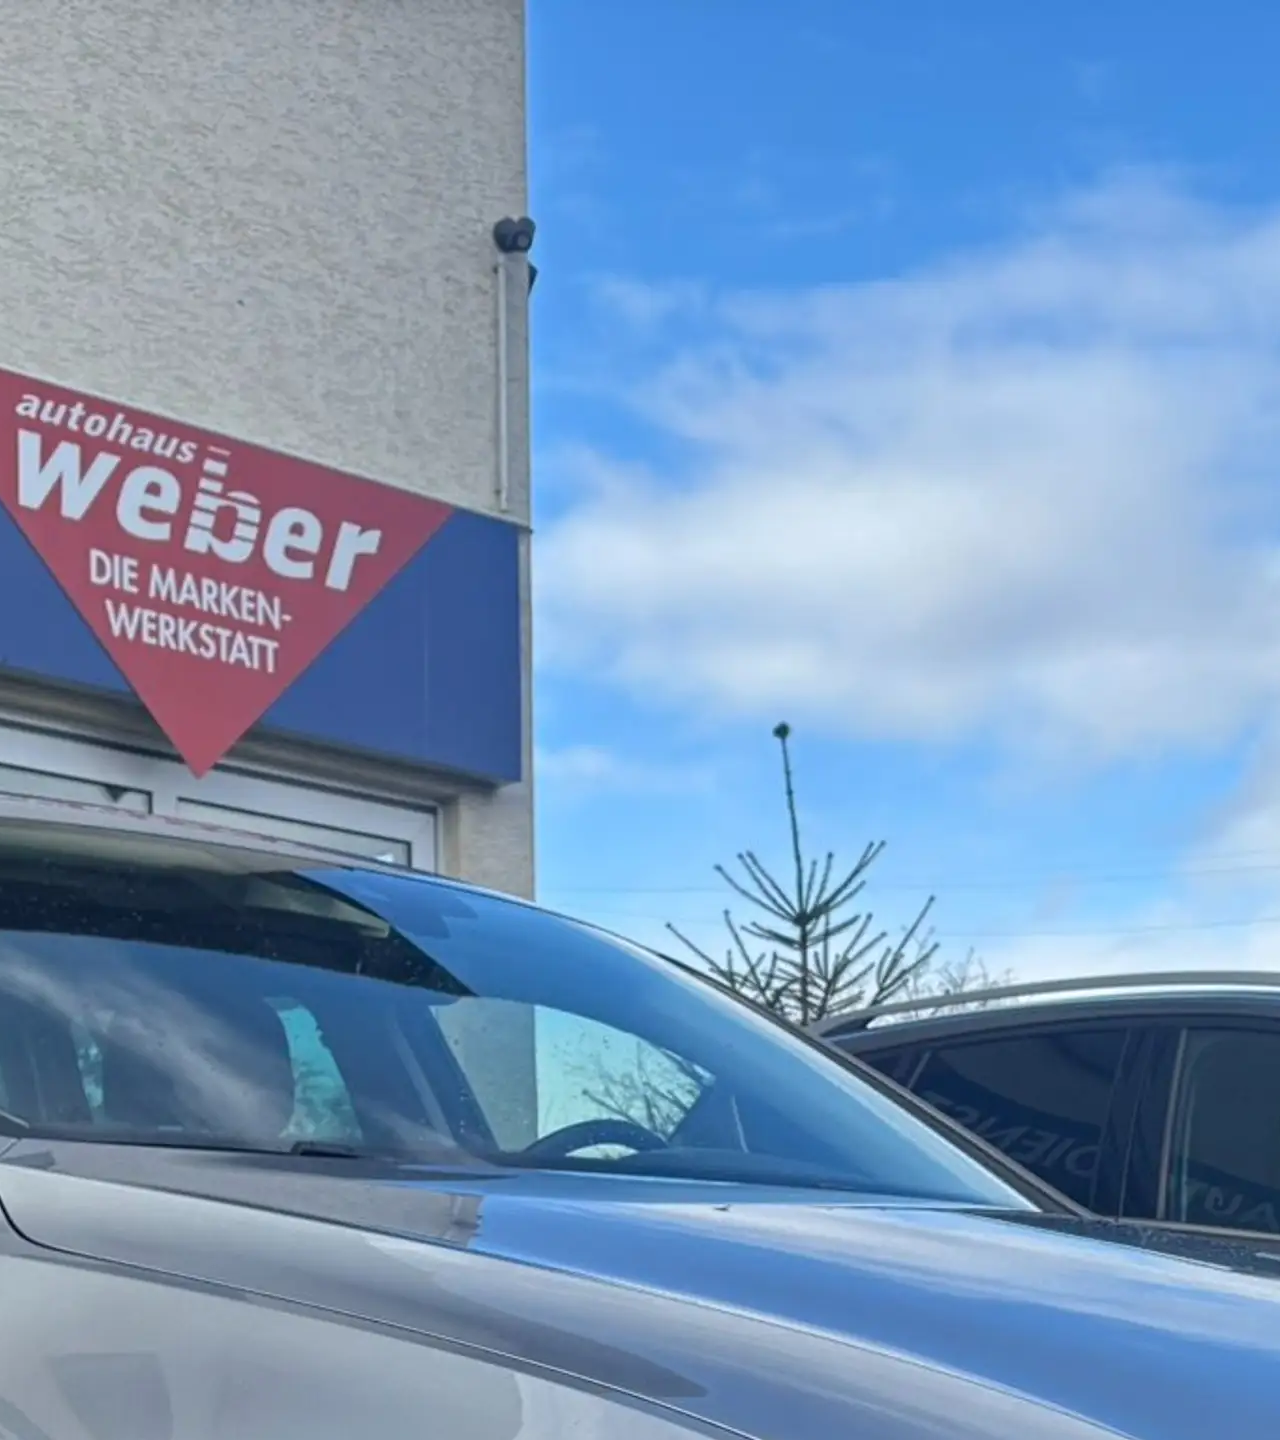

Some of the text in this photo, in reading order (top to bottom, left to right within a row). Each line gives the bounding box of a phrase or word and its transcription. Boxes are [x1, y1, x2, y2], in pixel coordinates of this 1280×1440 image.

[15, 391, 198, 463] autohaus
[16, 429, 384, 592] weber
[89, 550, 294, 631] DIE MARKEN-
[105, 599, 280, 673] WERKSTATT
